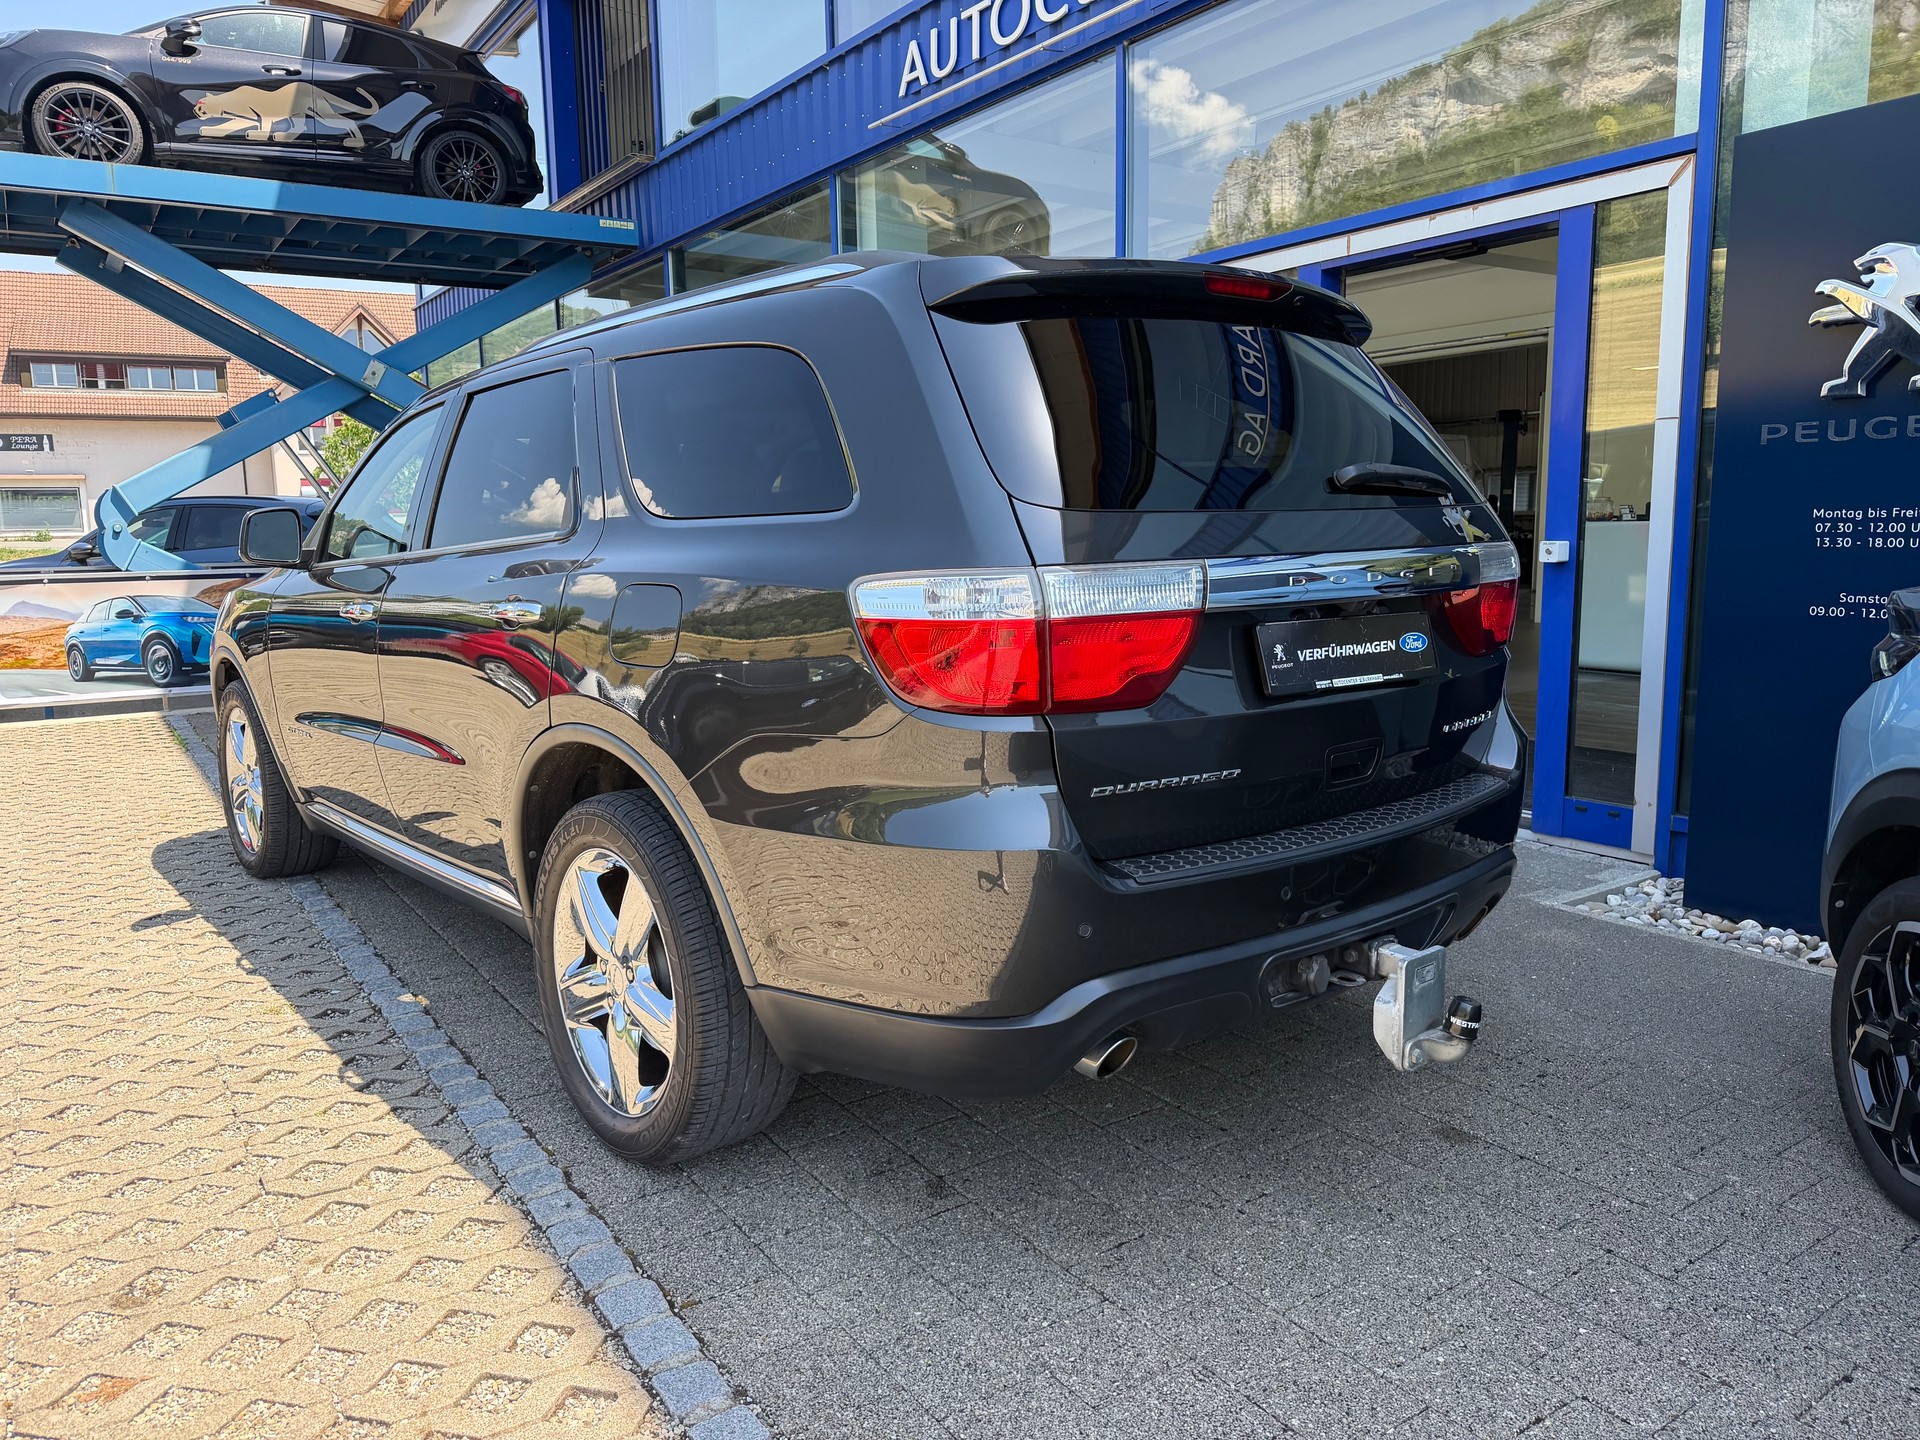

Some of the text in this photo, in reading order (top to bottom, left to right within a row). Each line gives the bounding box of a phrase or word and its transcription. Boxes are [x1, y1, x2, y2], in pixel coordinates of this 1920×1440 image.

[11, 443, 38, 451] Lounge
[1812, 507, 1920, 520] Montag bis Frei
[1815, 522, 1853, 533] 07.30
[1869, 522, 1906, 533] 12.00
[1815, 537, 1852, 548] 13.30
[1868, 537, 1905, 548] 18.00
[1839, 592, 1889, 604] Samsta
[1809, 606, 1846, 617] 09.00
[1861, 607, 1889, 619] 12.0
[1297, 639, 1396, 662] VERFÜHRWAGEN
[1090, 768, 1242, 798] DURANGO
[536, 842, 559, 919] SOLUS
